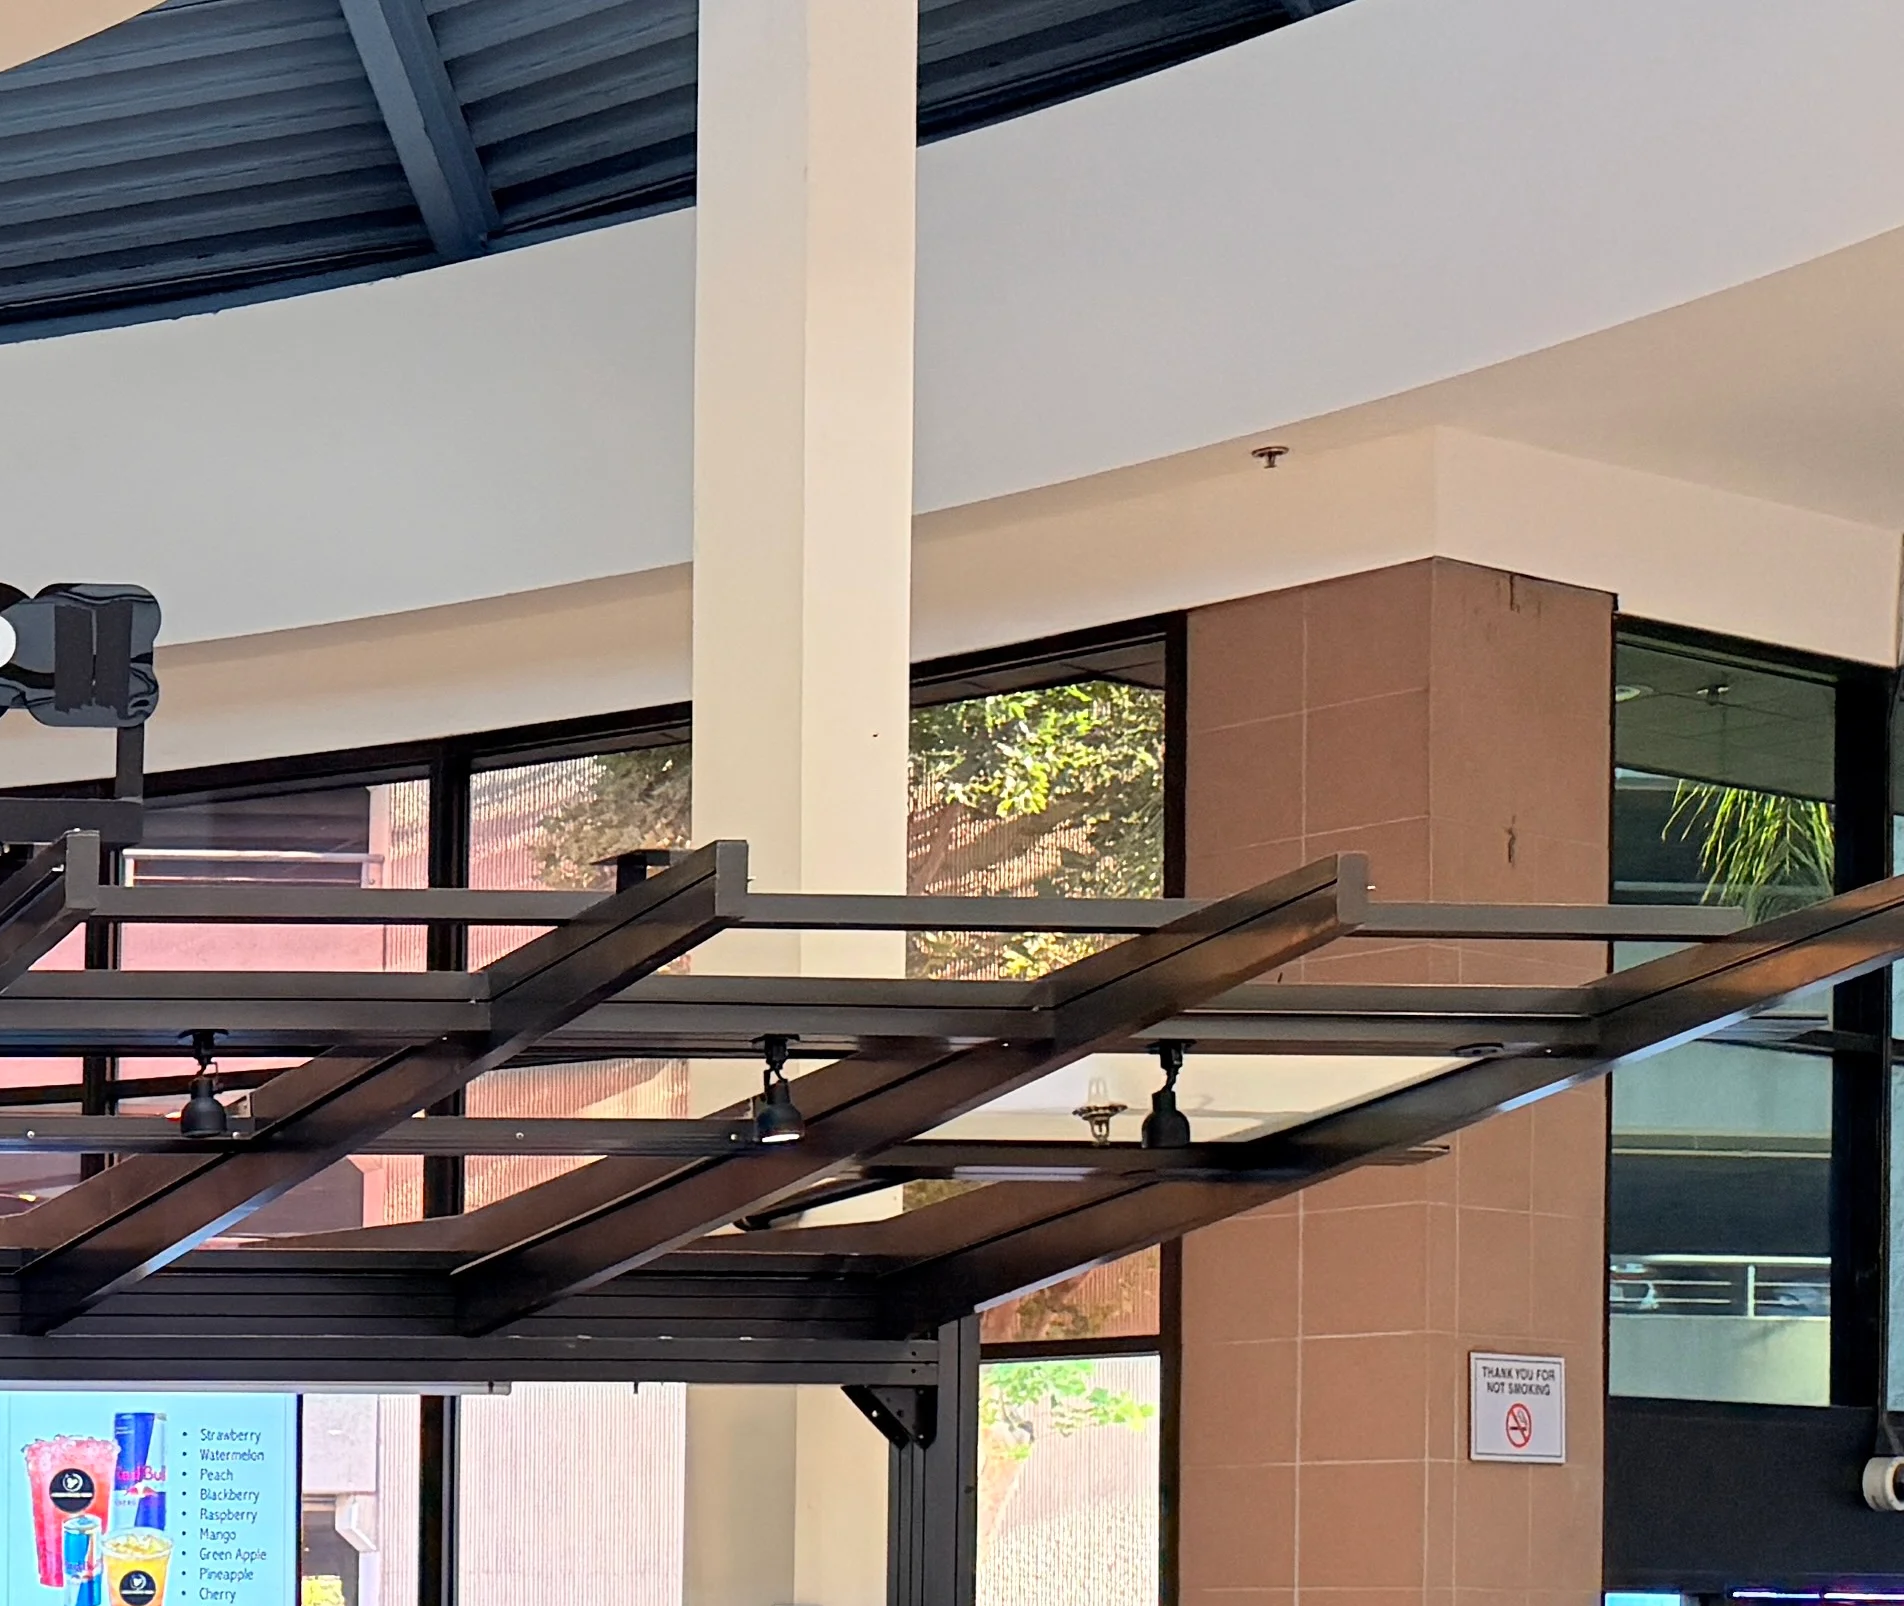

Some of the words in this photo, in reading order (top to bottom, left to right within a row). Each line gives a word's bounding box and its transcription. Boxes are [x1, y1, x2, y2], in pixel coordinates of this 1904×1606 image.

[1482, 1366, 1513, 1378] THANK
[1515, 1368, 1533, 1380] YOU
[1536, 1369, 1555, 1381] FOR
[1487, 1382, 1505, 1393] NOT
[1508, 1383, 1550, 1395] SMOKING
[200, 1428, 261, 1445] Strawberry
[199, 1448, 265, 1461] Watermelon
[200, 1468, 234, 1481] Peach
[200, 1488, 260, 1504] Blackberry
[200, 1508, 258, 1524] Raspberry
[199, 1528, 237, 1544] Mango
[199, 1547, 232, 1561] Green
[235, 1548, 267, 1564] Apple
[199, 1567, 254, 1583] Pineapple
[199, 1587, 237, 1604] Cherry
